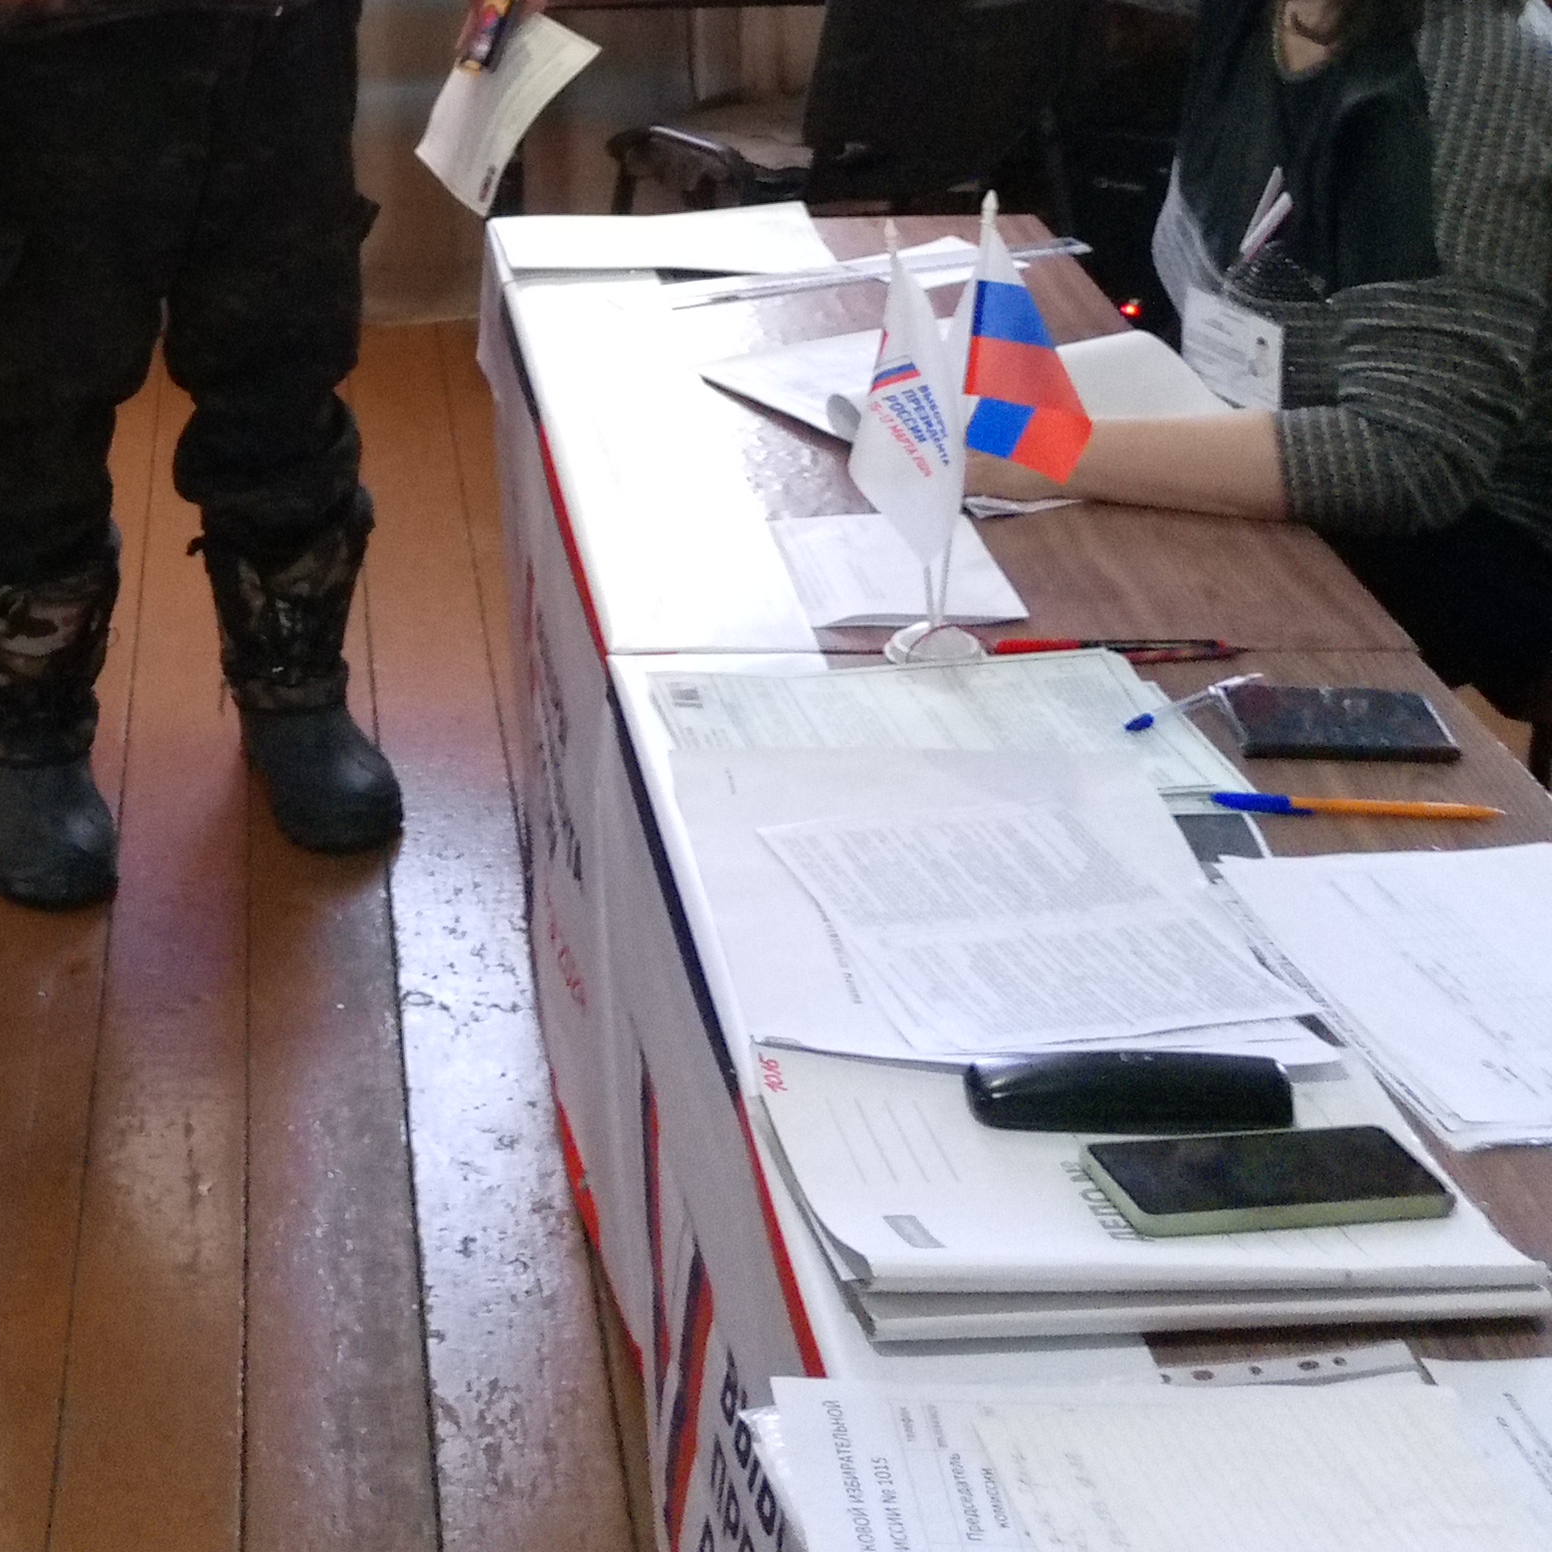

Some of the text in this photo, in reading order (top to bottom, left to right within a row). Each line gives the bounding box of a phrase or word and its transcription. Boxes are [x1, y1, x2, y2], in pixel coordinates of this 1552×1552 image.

[823, 1399, 865, 1504] ИЗБИРАТЕЛЬНОЙ
[870, 1456, 894, 1486] 1015
[949, 1453, 985, 1541] Председатель
[982, 1468, 1010, 1528] комиссии
[884, 1507, 911, 1552] ИССИИ
